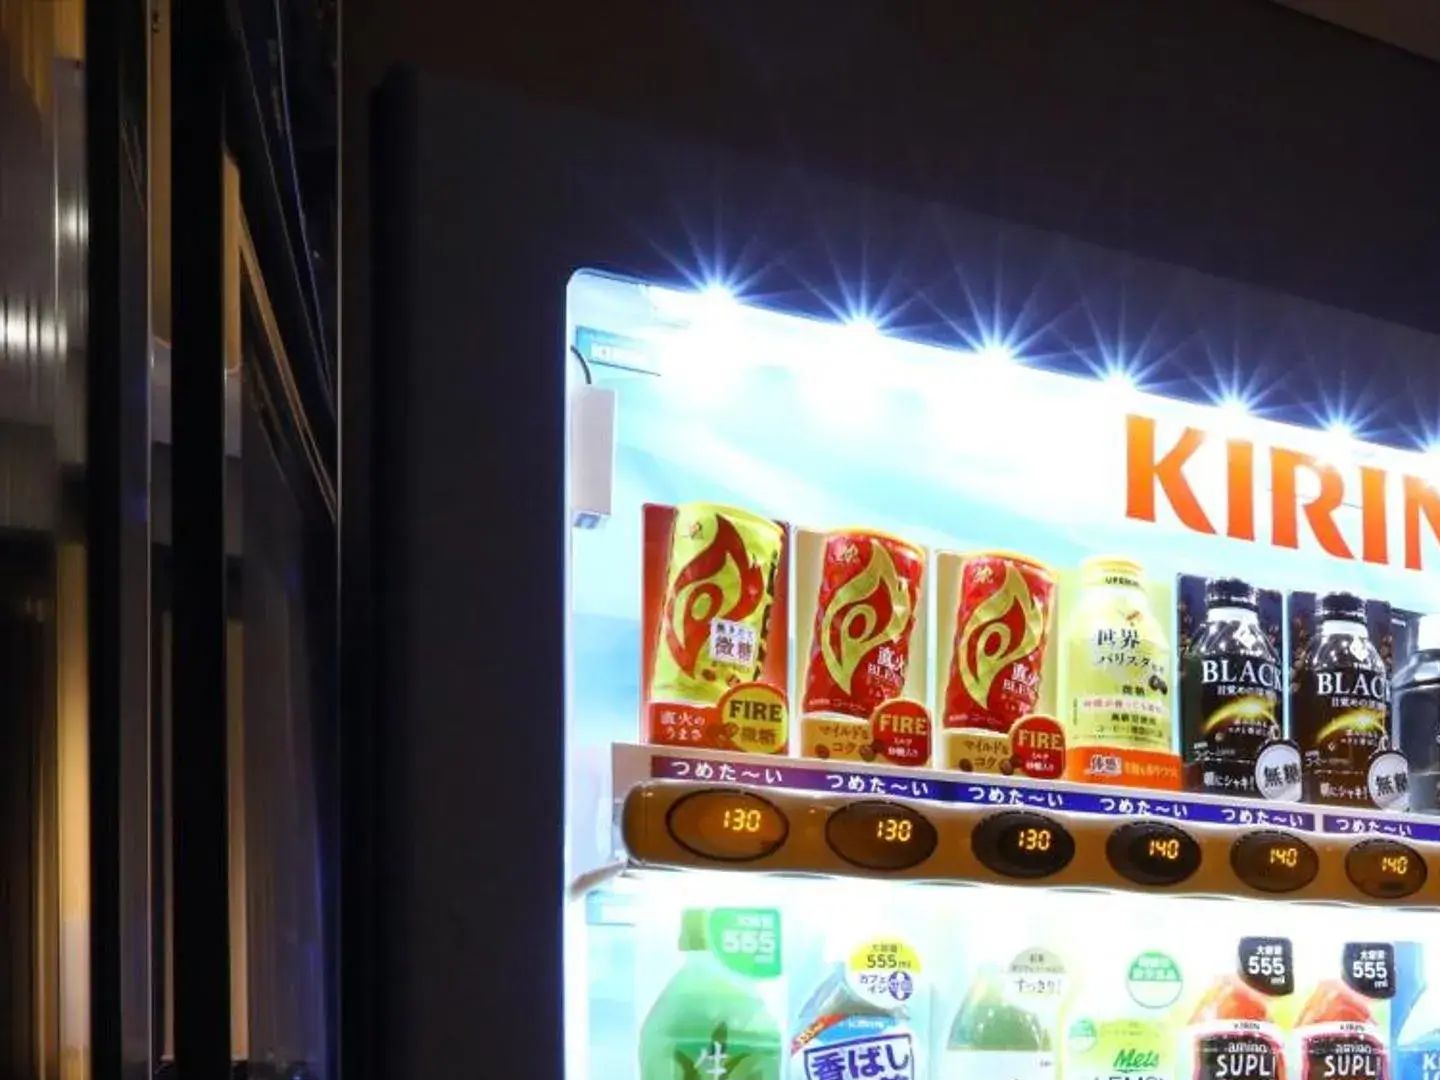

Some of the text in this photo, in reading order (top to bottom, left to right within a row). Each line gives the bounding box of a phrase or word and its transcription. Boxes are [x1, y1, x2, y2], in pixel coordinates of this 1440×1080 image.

[729, 700, 782, 722] FIRE
[880, 713, 928, 735] FIRE
[1018, 729, 1064, 751] FIRE
[722, 808, 761, 833] 130
[876, 819, 911, 842] 130
[1017, 830, 1051, 851] 130
[1148, 838, 1180, 860] 140
[1270, 847, 1298, 868] 140
[1382, 856, 1409, 875] 140
[1248, 956, 1285, 975] 555
[1353, 961, 1387, 979] 555
[1228, 1042, 1267, 1053] amino
[1336, 1043, 1371, 1054] amino
[1216, 1053, 1276, 1077] SUPLI
